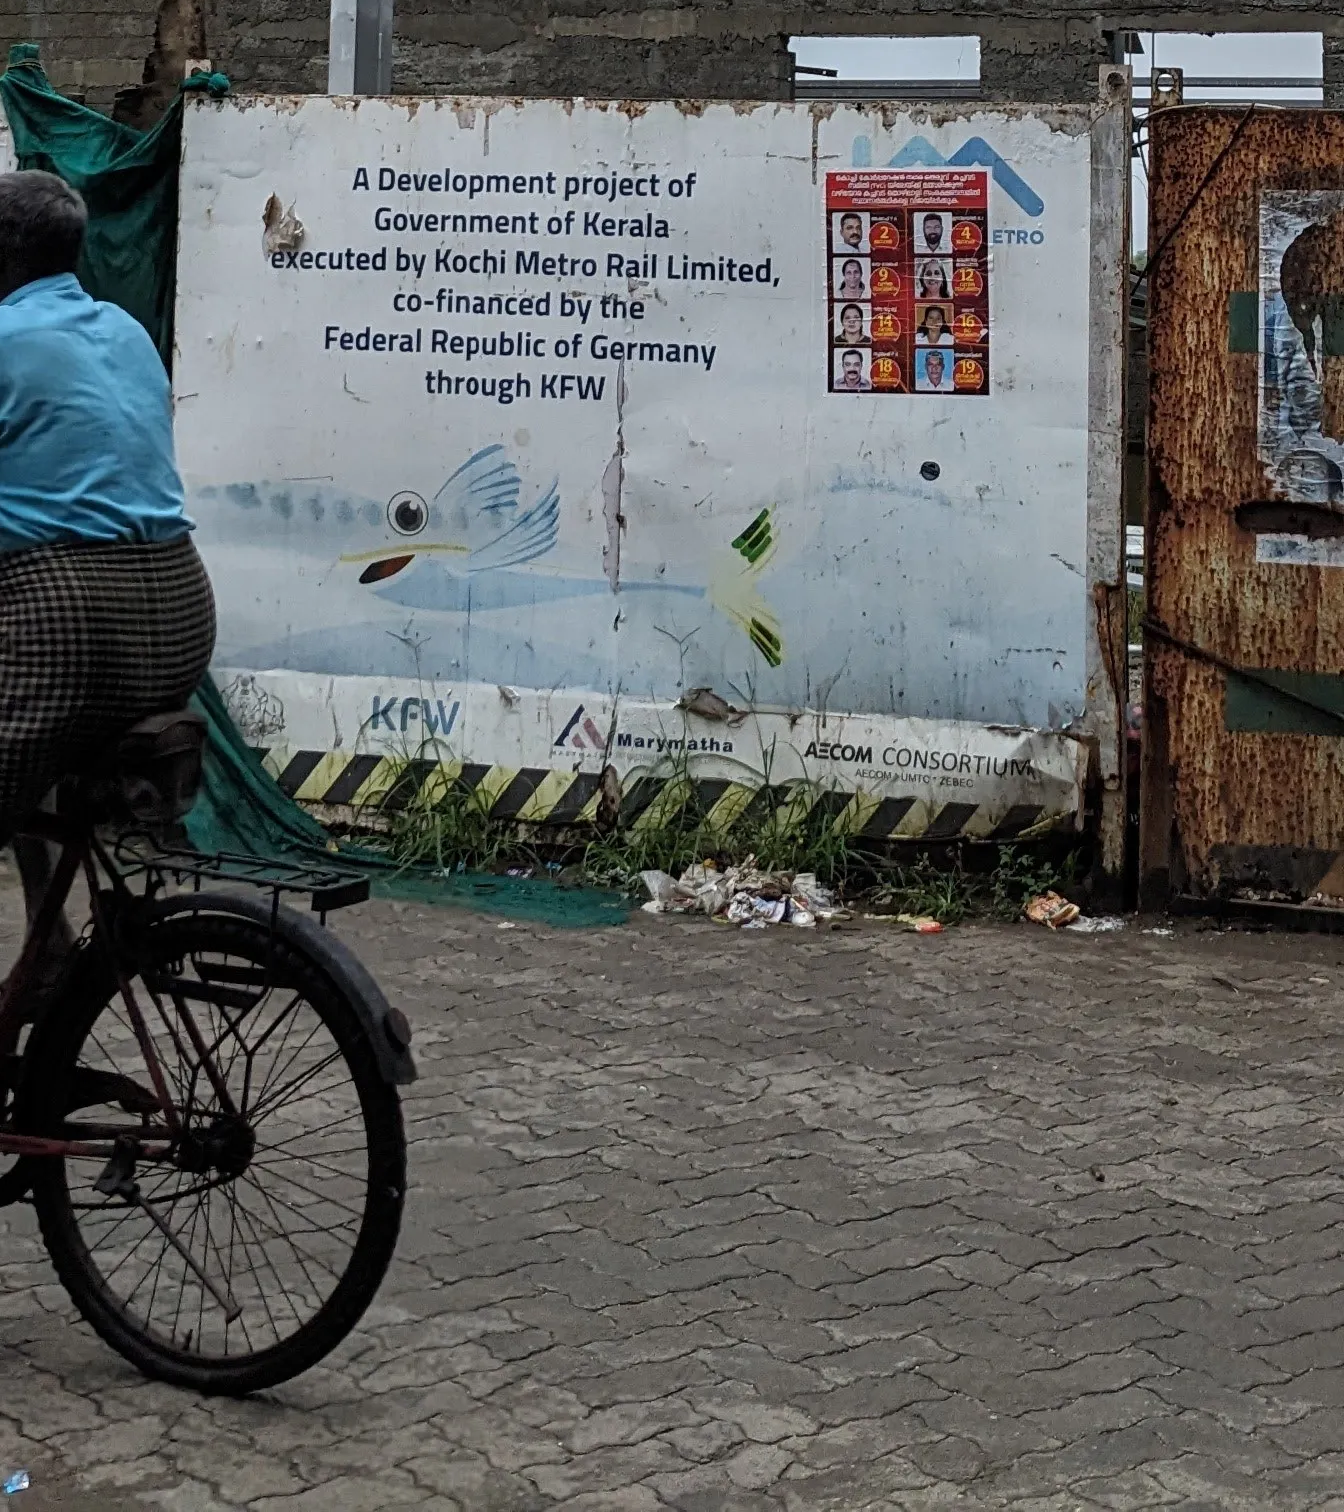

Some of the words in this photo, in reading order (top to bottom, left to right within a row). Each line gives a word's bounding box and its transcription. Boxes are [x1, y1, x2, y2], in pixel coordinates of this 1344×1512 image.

[352, 168, 370, 191] A
[378, 168, 556, 199] Development
[564, 171, 660, 202] project
[668, 172, 697, 198] of
[375, 207, 539, 234] Government
[547, 211, 575, 235] of
[583, 211, 670, 238] Kerala
[880, 226, 889, 239] 2
[961, 227, 972, 240] 4
[992, 229, 1044, 244] ETRO
[271, 247, 387, 271] executed
[396, 247, 426, 278] by
[435, 248, 505, 275] Kochi
[515, 250, 597, 277] Metro
[607, 253, 657, 278] Rail
[667, 255, 780, 287] Limited,
[879, 269, 888, 281] 9
[959, 269, 974, 281] 12
[393, 288, 551, 316] co-financed
[560, 292, 592, 324] by
[600, 293, 645, 319] the
[878, 314, 892, 327] 14
[962, 316, 975, 328] 16
[324, 326, 422, 353] Federal
[432, 329, 545, 361] Republic
[554, 333, 583, 358] of
[590, 335, 716, 371] Germany
[878, 359, 892, 372] 18
[962, 360, 975, 372] 19
[426, 370, 531, 404] through
[541, 373, 606, 400] KFW
[617, 733, 733, 753] Marymatha
[804, 741, 872, 764] AECOM
[882, 747, 1036, 779] CONSORTIUM
[856, 768, 892, 780] AECOM
